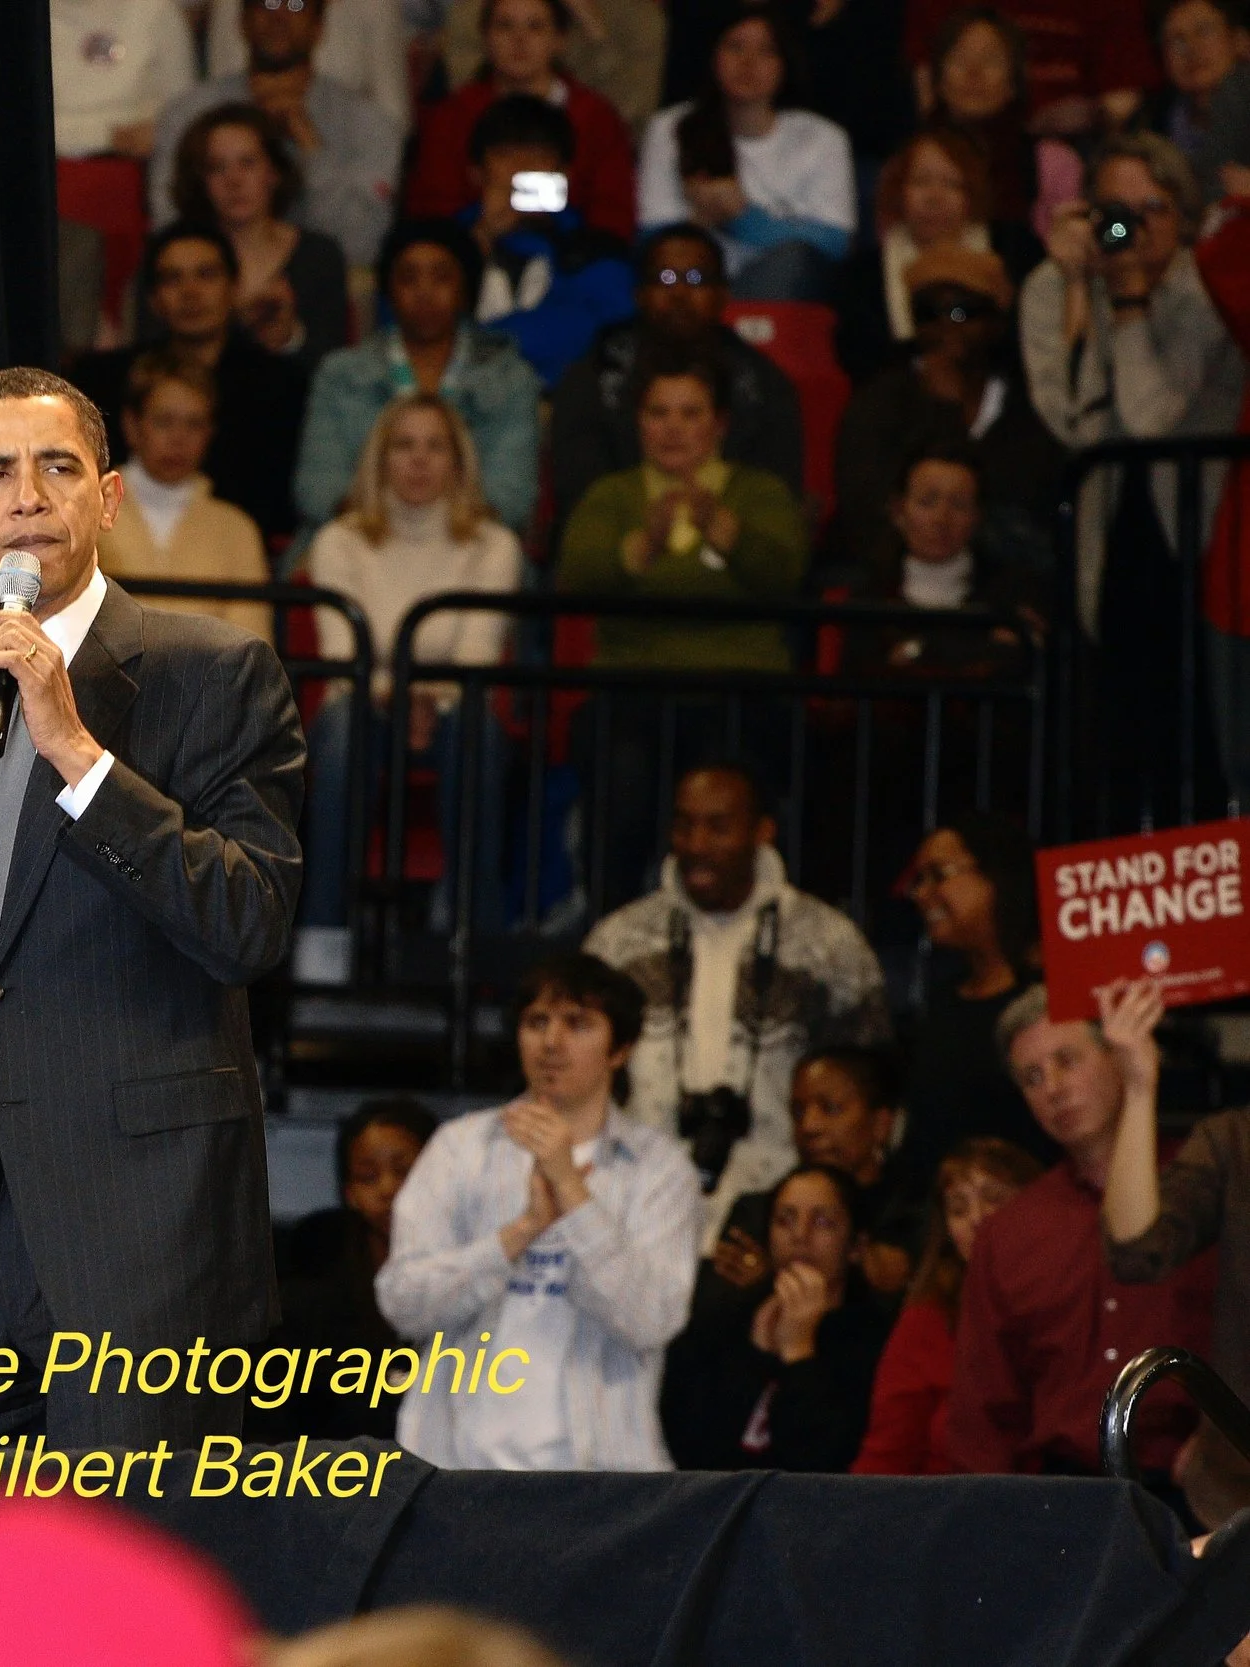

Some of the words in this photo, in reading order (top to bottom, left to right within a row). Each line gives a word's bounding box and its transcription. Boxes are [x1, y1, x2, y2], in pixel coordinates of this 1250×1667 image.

[1055, 851, 1167, 898] STAND
[1173, 838, 1240, 879] FOR
[1057, 874, 1244, 941] CHANGE
